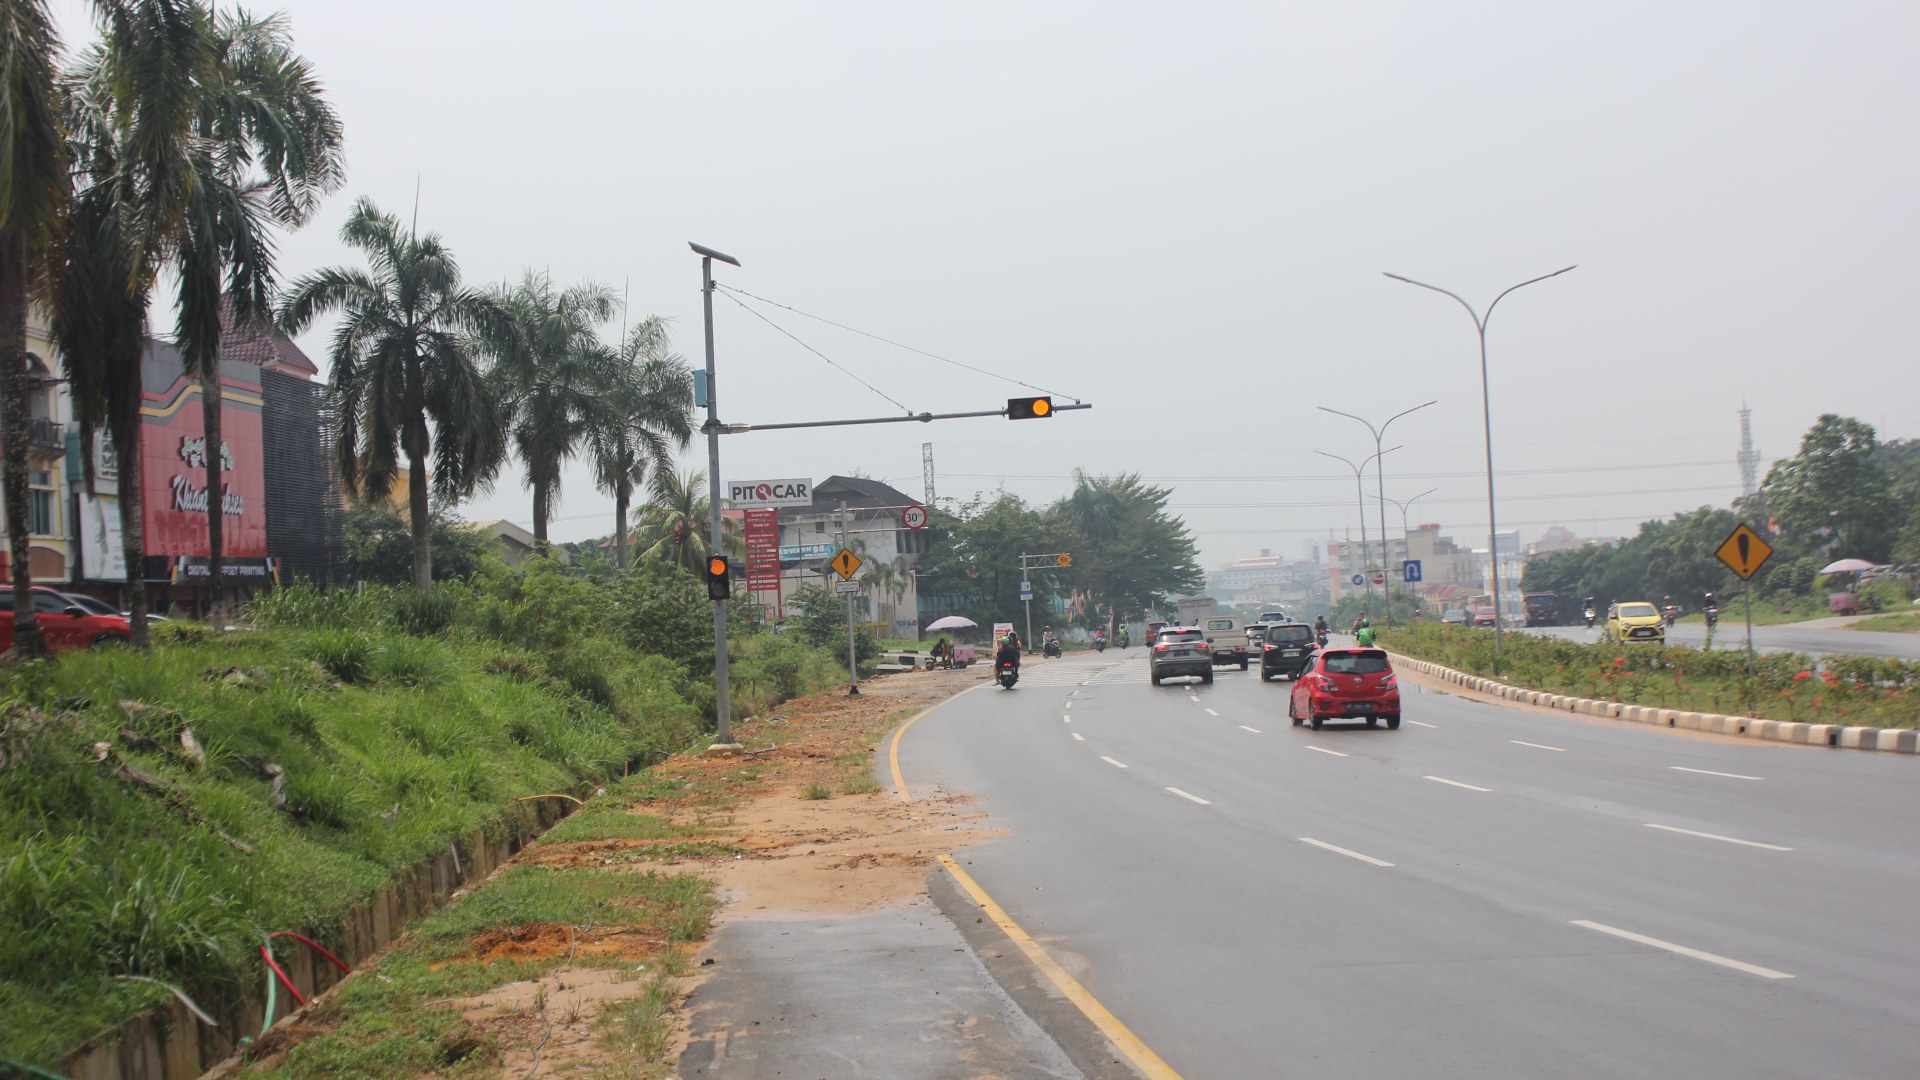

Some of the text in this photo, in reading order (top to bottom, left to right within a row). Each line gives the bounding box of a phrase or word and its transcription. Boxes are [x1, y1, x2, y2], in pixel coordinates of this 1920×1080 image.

[906, 512, 918, 523] 30
[812, 544, 825, 553] 98
[188, 565, 265, 576] DIGITAL FFSET PRINTING
